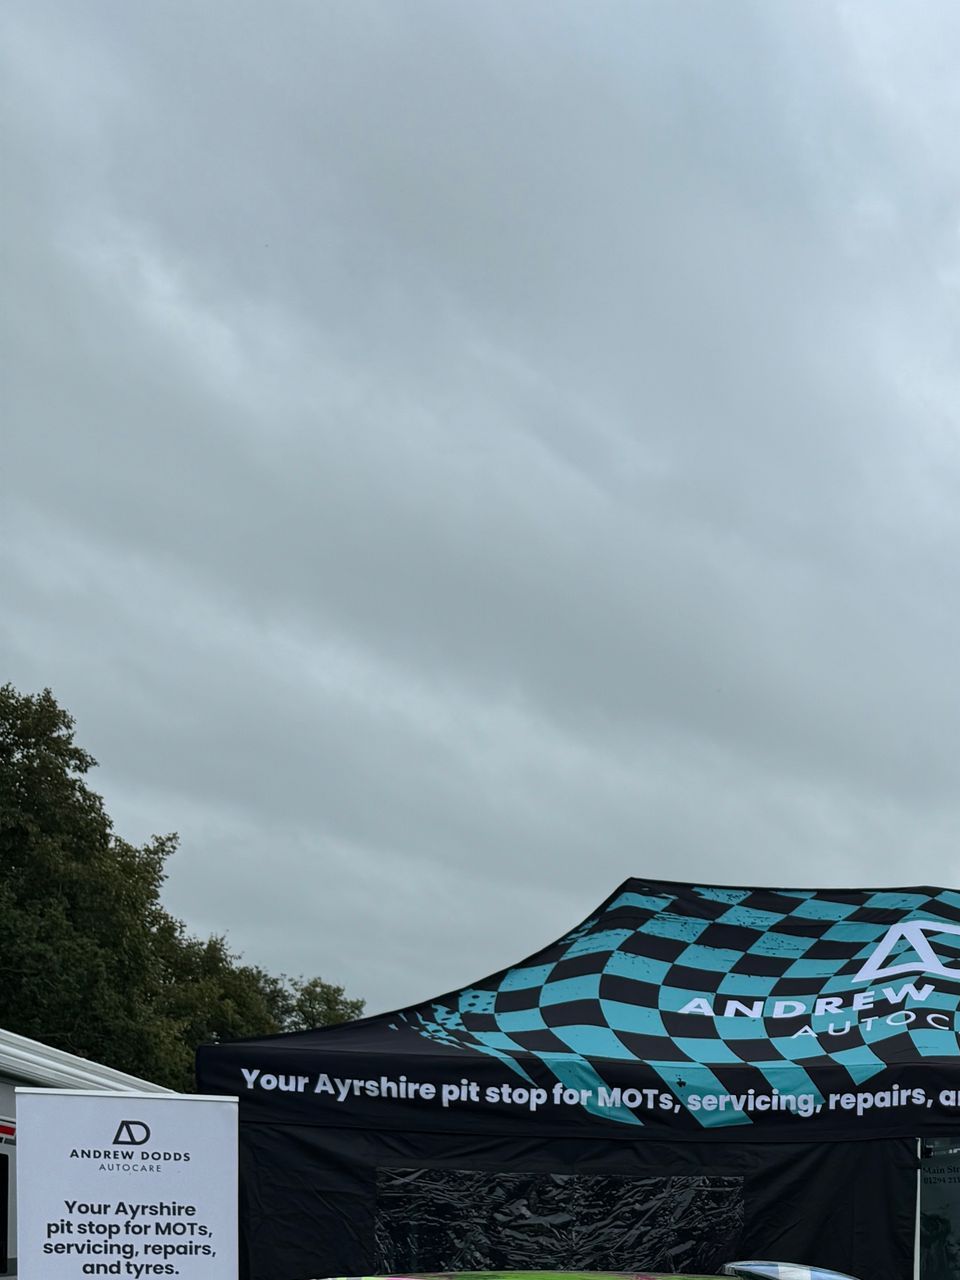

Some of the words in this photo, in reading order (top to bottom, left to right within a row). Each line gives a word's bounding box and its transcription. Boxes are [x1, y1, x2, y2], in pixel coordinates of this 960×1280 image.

[678, 984, 935, 1019] ANDREW
[241, 1069, 308, 1093] Your
[314, 1073, 436, 1102] Ayrshire
[442, 1079, 479, 1106] pit
[485, 1084, 548, 1110] stop
[553, 1082, 592, 1105] for
[597, 1087, 681, 1113] MOTs,
[687, 1088, 821, 1116] servicing,
[828, 1085, 931, 1115] repairs,
[70, 1149, 135, 1160] ANDREW
[141, 1151, 191, 1162] DODDS
[99, 1164, 162, 1173] AUTOCARE
[64, 1200, 111, 1215] Your
[115, 1202, 196, 1219] Ayrshire
[46, 1220, 73, 1239] pit
[77, 1222, 121, 1239] stop
[124, 1221, 151, 1235] for
[155, 1223, 213, 1238] MOTs,
[43, 1241, 139, 1259] servicing,
[143, 1241, 216, 1259] repairs,
[82, 1261, 121, 1275] and
[126, 1263, 180, 1279] tyres.
